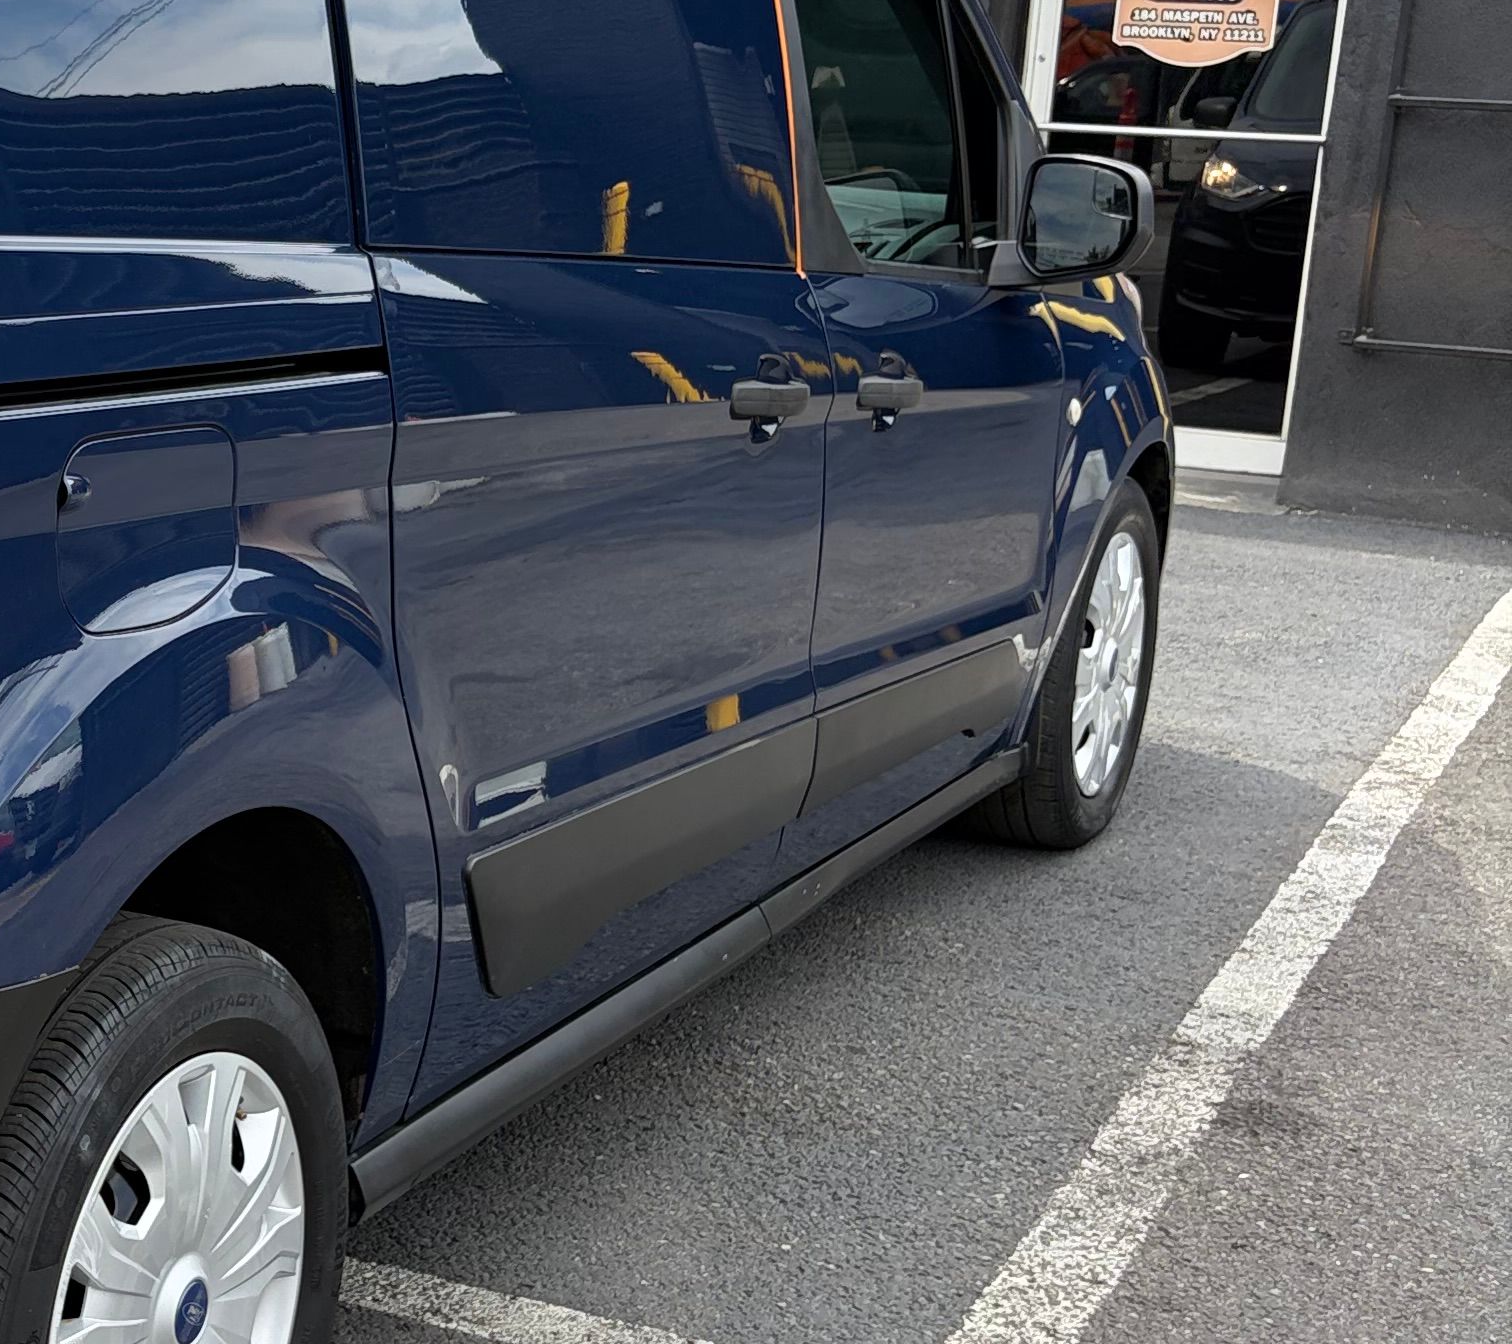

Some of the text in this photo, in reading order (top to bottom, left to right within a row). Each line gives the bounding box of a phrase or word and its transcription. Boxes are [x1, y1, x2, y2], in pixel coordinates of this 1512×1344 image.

[1133, 10, 1258, 24] 184 MASPETH AVE.
[1122, 26, 1264, 41] BROOKLYN, NY 11211
